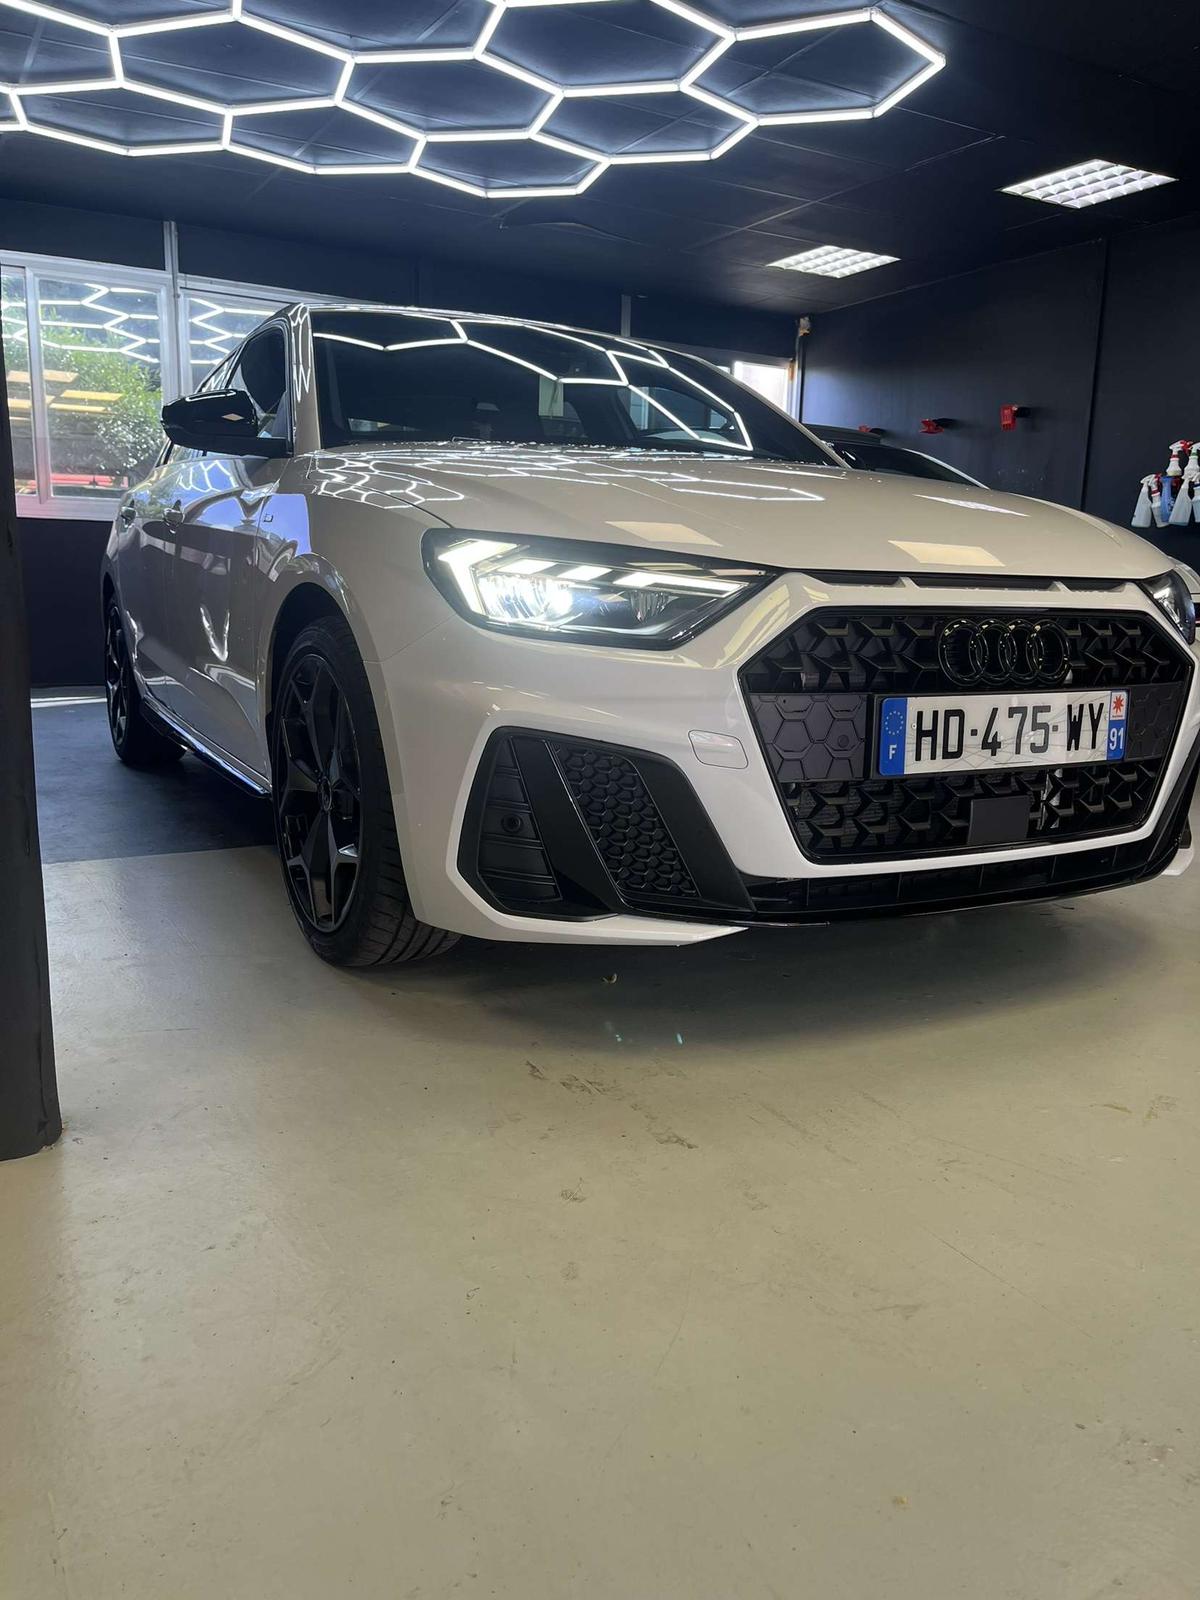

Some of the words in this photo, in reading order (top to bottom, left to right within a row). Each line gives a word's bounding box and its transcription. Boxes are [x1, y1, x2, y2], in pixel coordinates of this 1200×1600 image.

[915, 702, 1105, 762] HD-475-WY
[1109, 727, 1125, 751] 91
[888, 744, 898, 760] F
